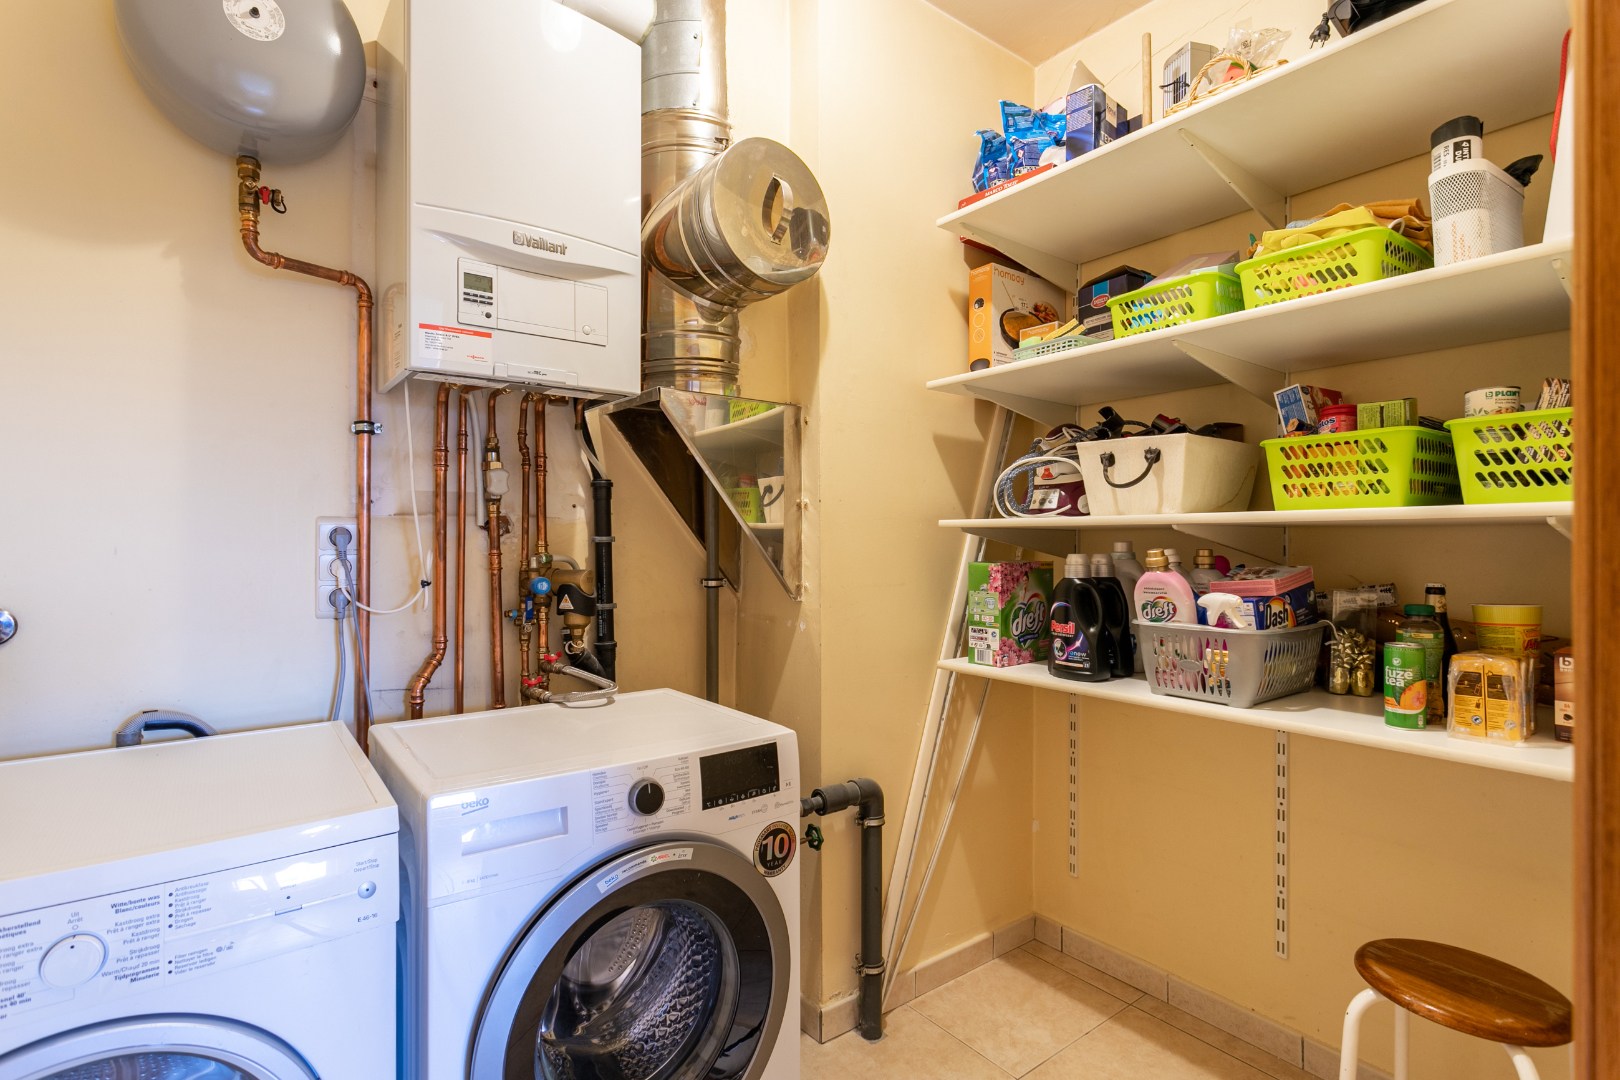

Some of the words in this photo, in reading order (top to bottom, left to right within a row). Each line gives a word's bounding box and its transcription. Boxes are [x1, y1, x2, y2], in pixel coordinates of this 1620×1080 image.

[525, 233, 567, 256] Vaillant
[1012, 601, 1044, 636] dreft
[1143, 602, 1174, 620] dreft
[1265, 601, 1288, 630] Dash
[1051, 620, 1075, 634] Persil
[1386, 666, 1413, 680] fuze
[1386, 676, 1404, 687] tea
[762, 833, 789, 861] 10
[605, 874, 618, 885] beko
